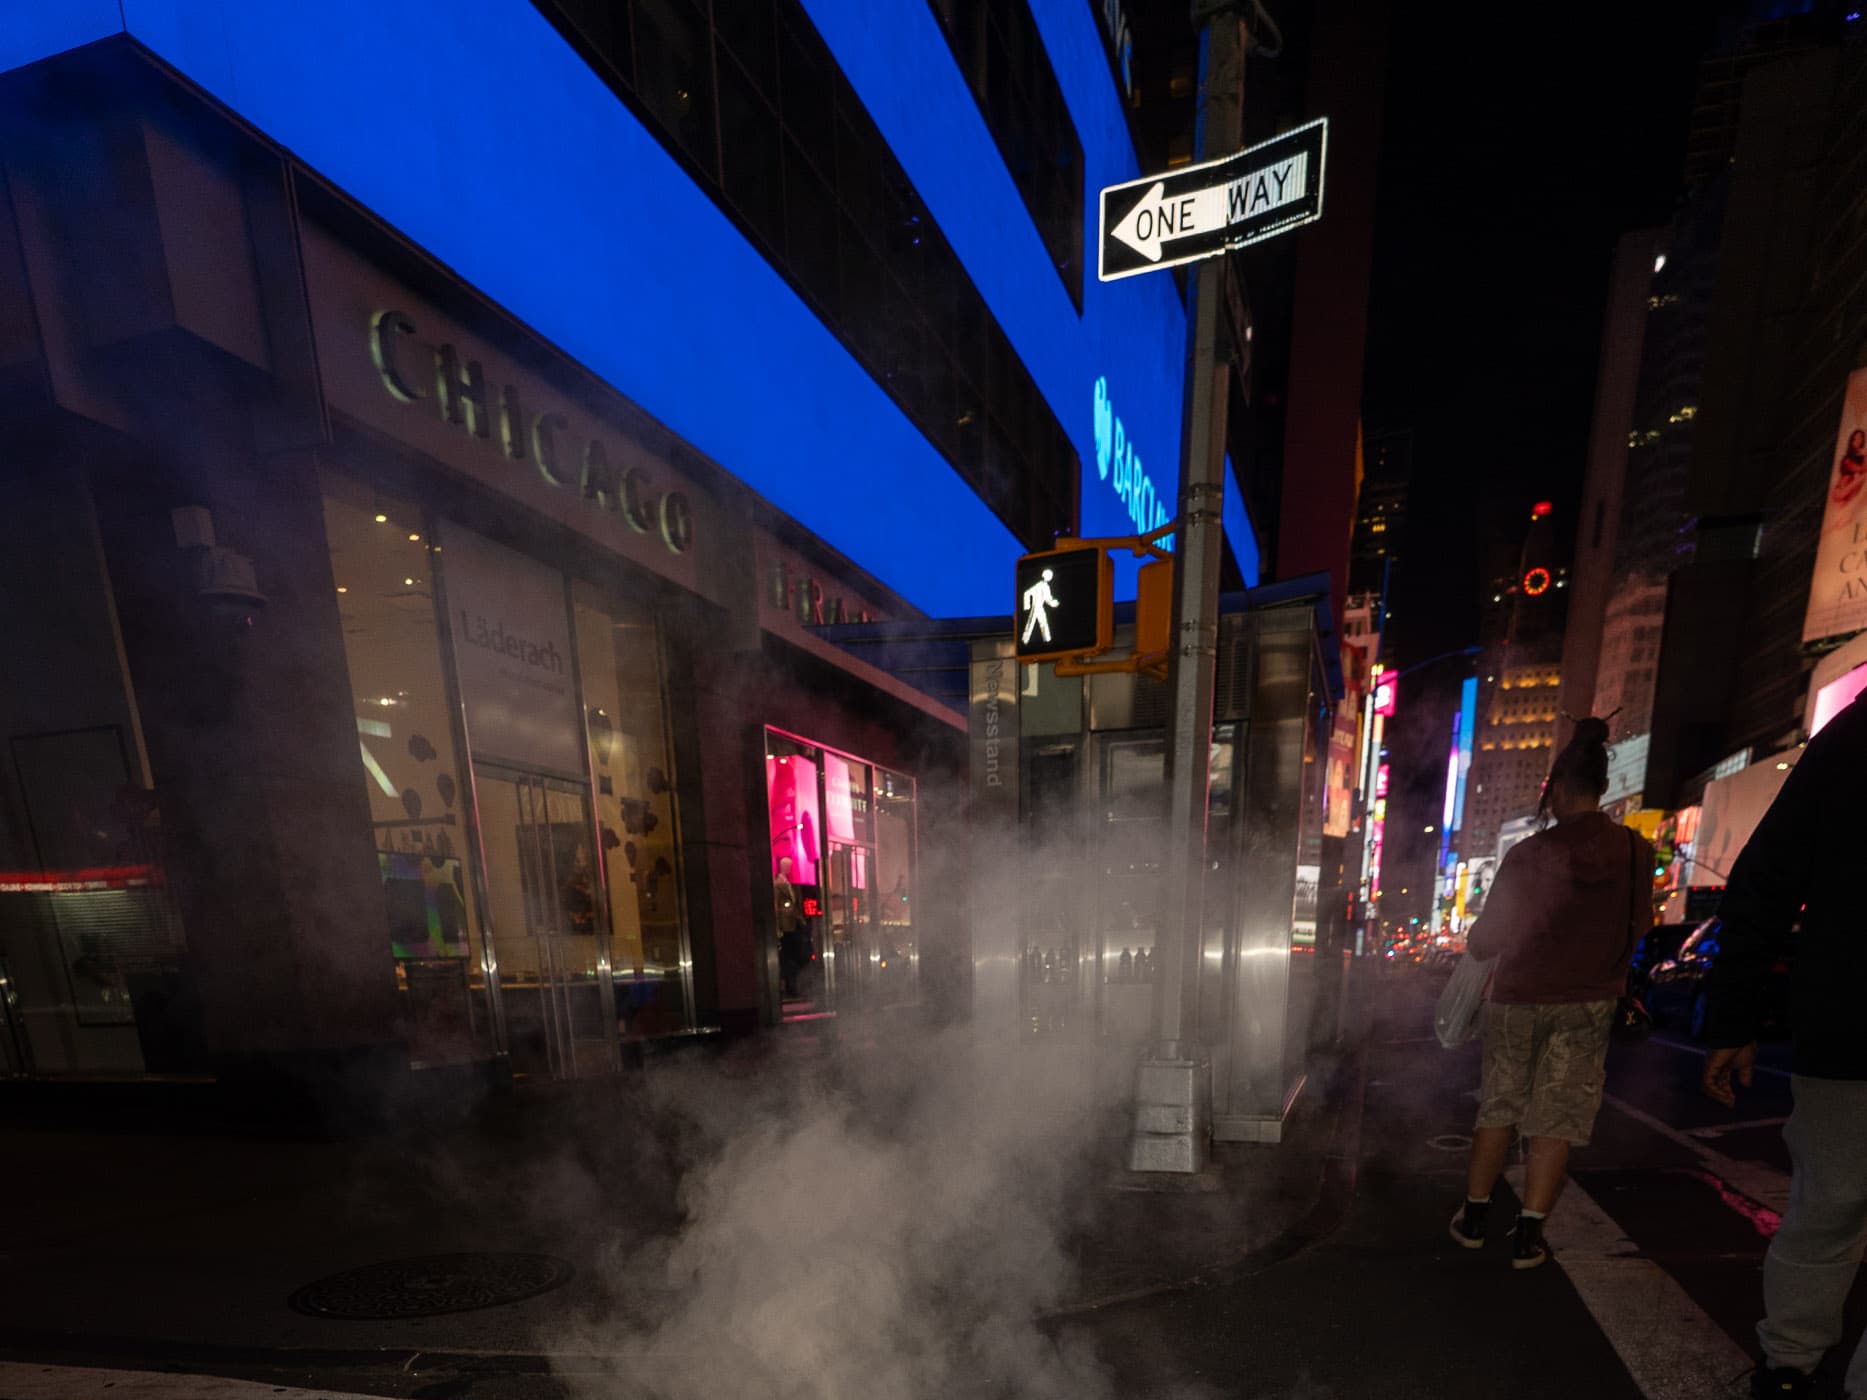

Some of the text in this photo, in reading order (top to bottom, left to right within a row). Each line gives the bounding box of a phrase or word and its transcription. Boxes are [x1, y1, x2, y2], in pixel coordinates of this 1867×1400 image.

[1136, 198, 1195, 241] ONE
[1229, 164, 1293, 219] WAY
[370, 309, 689, 556] CHICAGO
[461, 609, 562, 675] Läderach
[985, 660, 1003, 787] Newsstand
